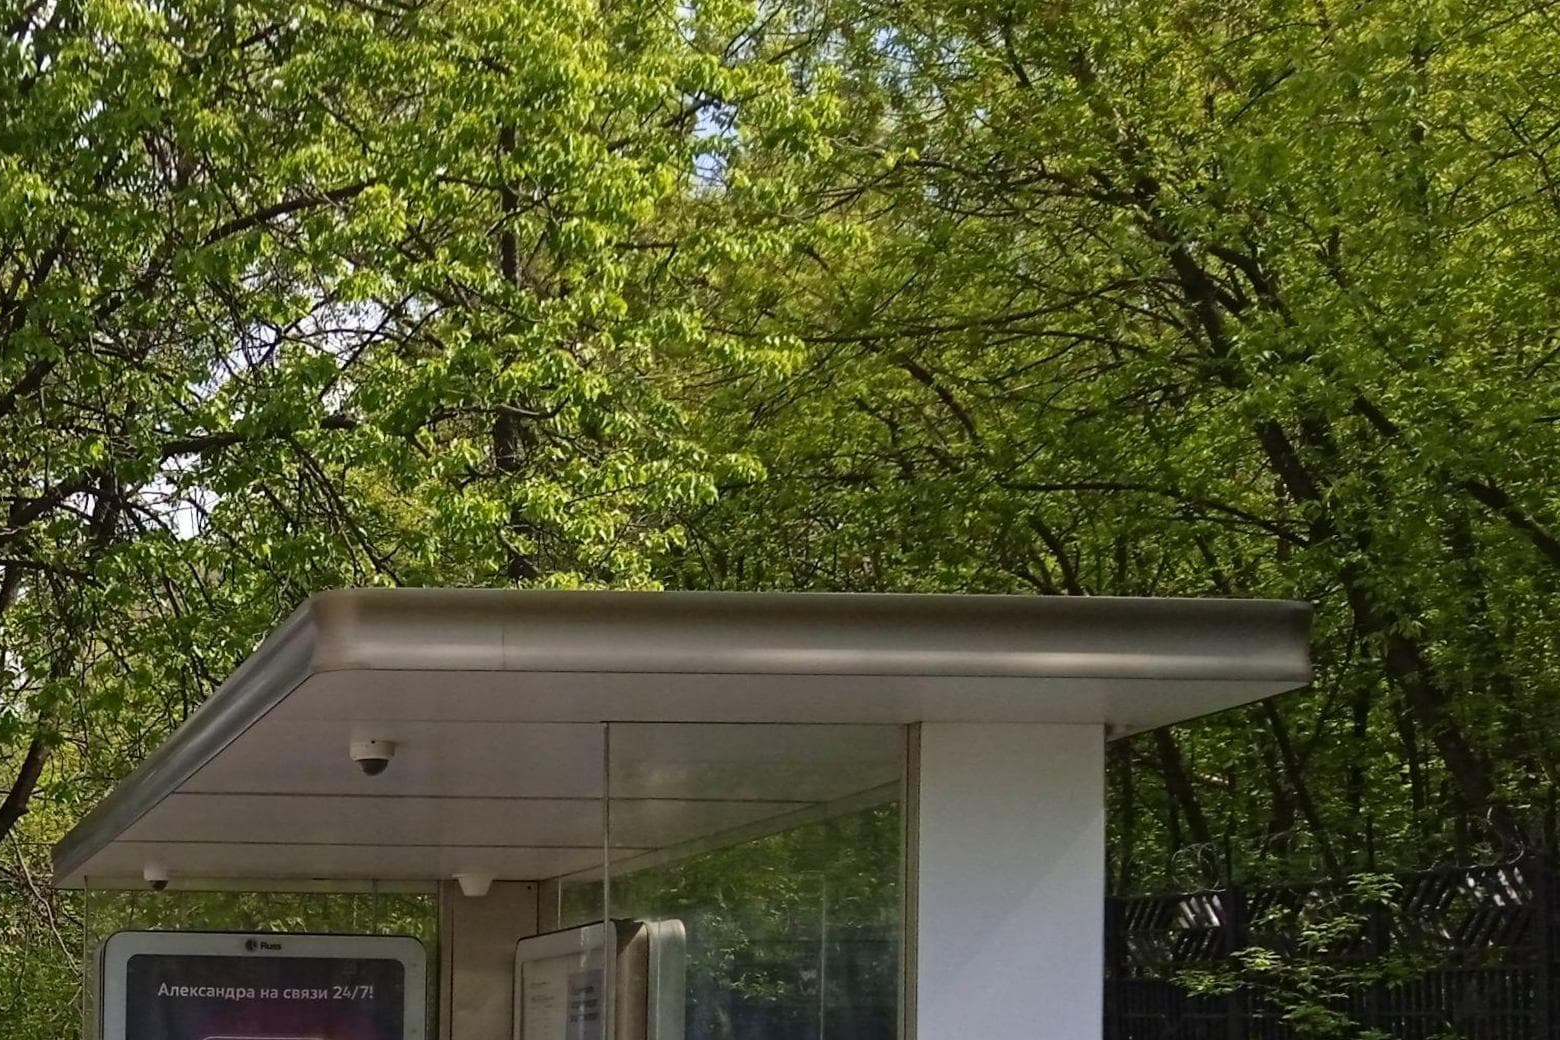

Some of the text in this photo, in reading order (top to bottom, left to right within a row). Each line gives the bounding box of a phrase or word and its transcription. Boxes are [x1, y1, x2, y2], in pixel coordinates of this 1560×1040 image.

[158, 982, 374, 1000] Александра на связи 24/7!
